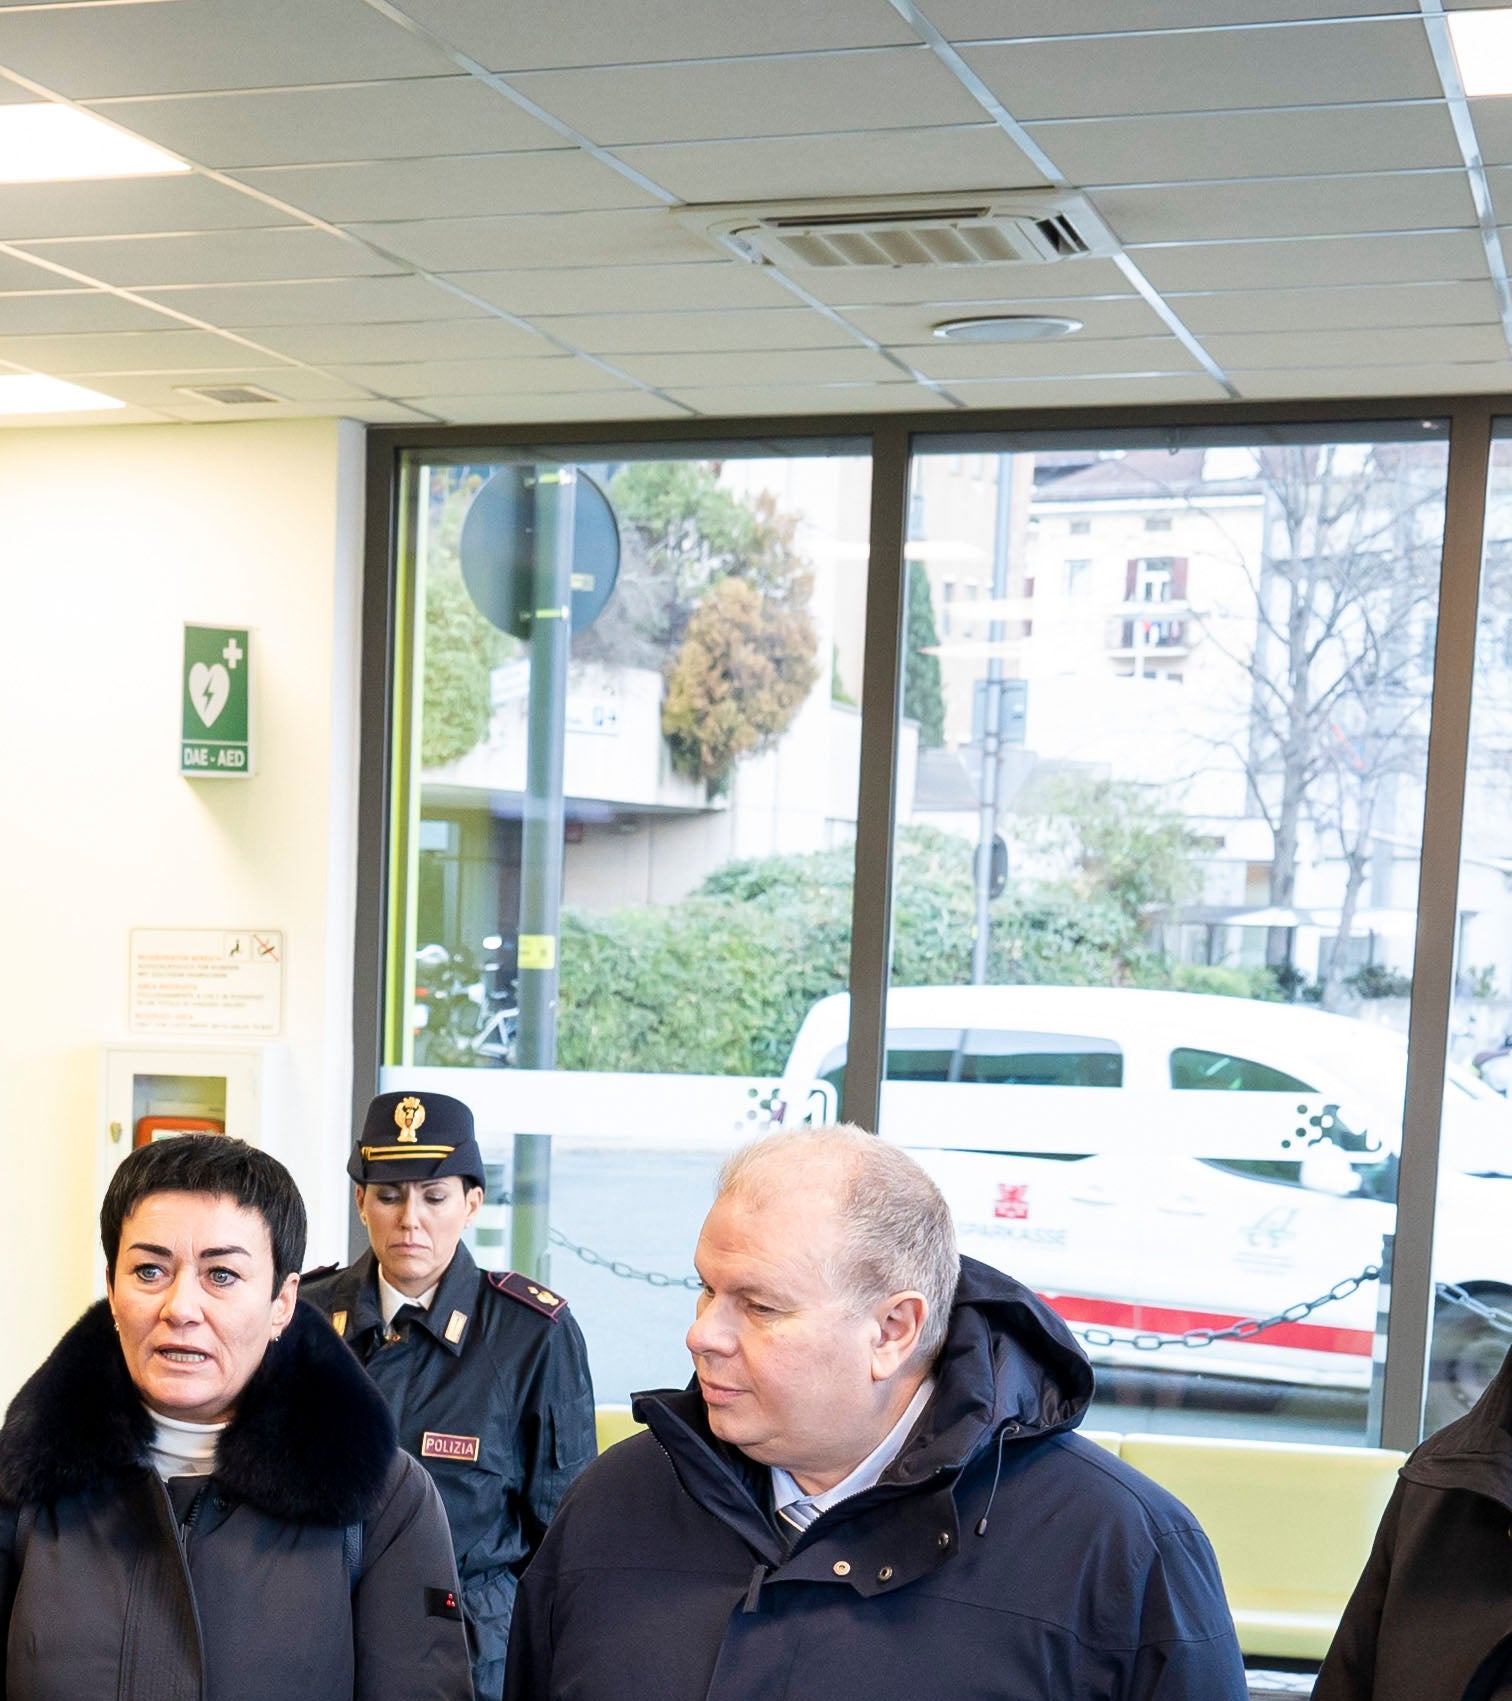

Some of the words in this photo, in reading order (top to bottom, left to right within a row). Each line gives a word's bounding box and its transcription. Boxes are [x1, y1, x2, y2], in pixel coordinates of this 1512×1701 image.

[183, 747, 209, 766] DAE
[217, 748, 246, 767] AED
[425, 1437, 474, 1456] POLIZIA
